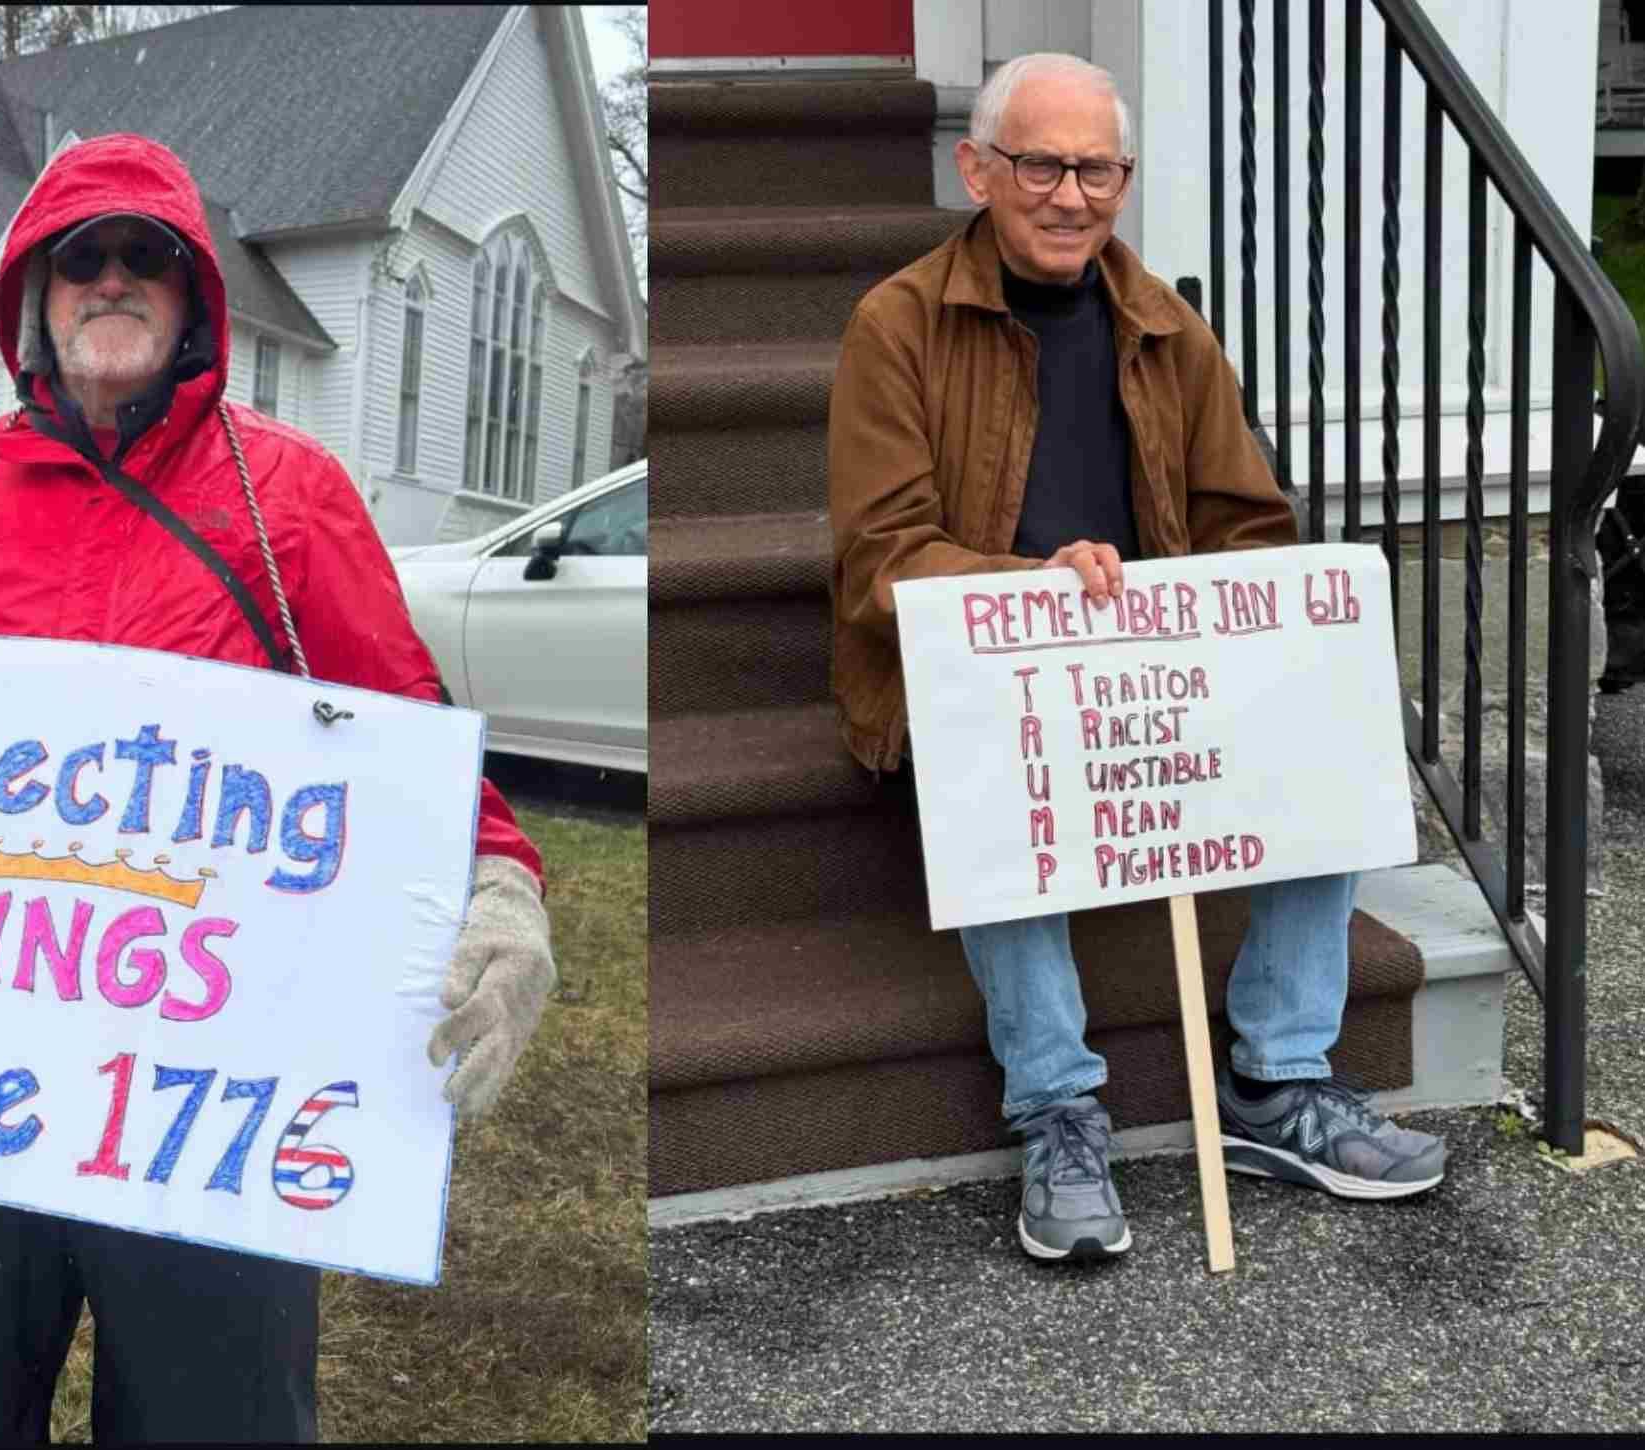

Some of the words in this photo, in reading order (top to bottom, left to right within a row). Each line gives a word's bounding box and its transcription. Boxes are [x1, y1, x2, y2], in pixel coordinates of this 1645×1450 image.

[962, 582, 1198, 647] REMEMBER
[1211, 579, 1277, 634] JAN
[1085, 748, 1223, 793] UNSTABLE
[1093, 800, 1182, 838] MEAN
[1094, 834, 1265, 888] PIGHEADED
[76, 1052, 359, 1210] 1776
